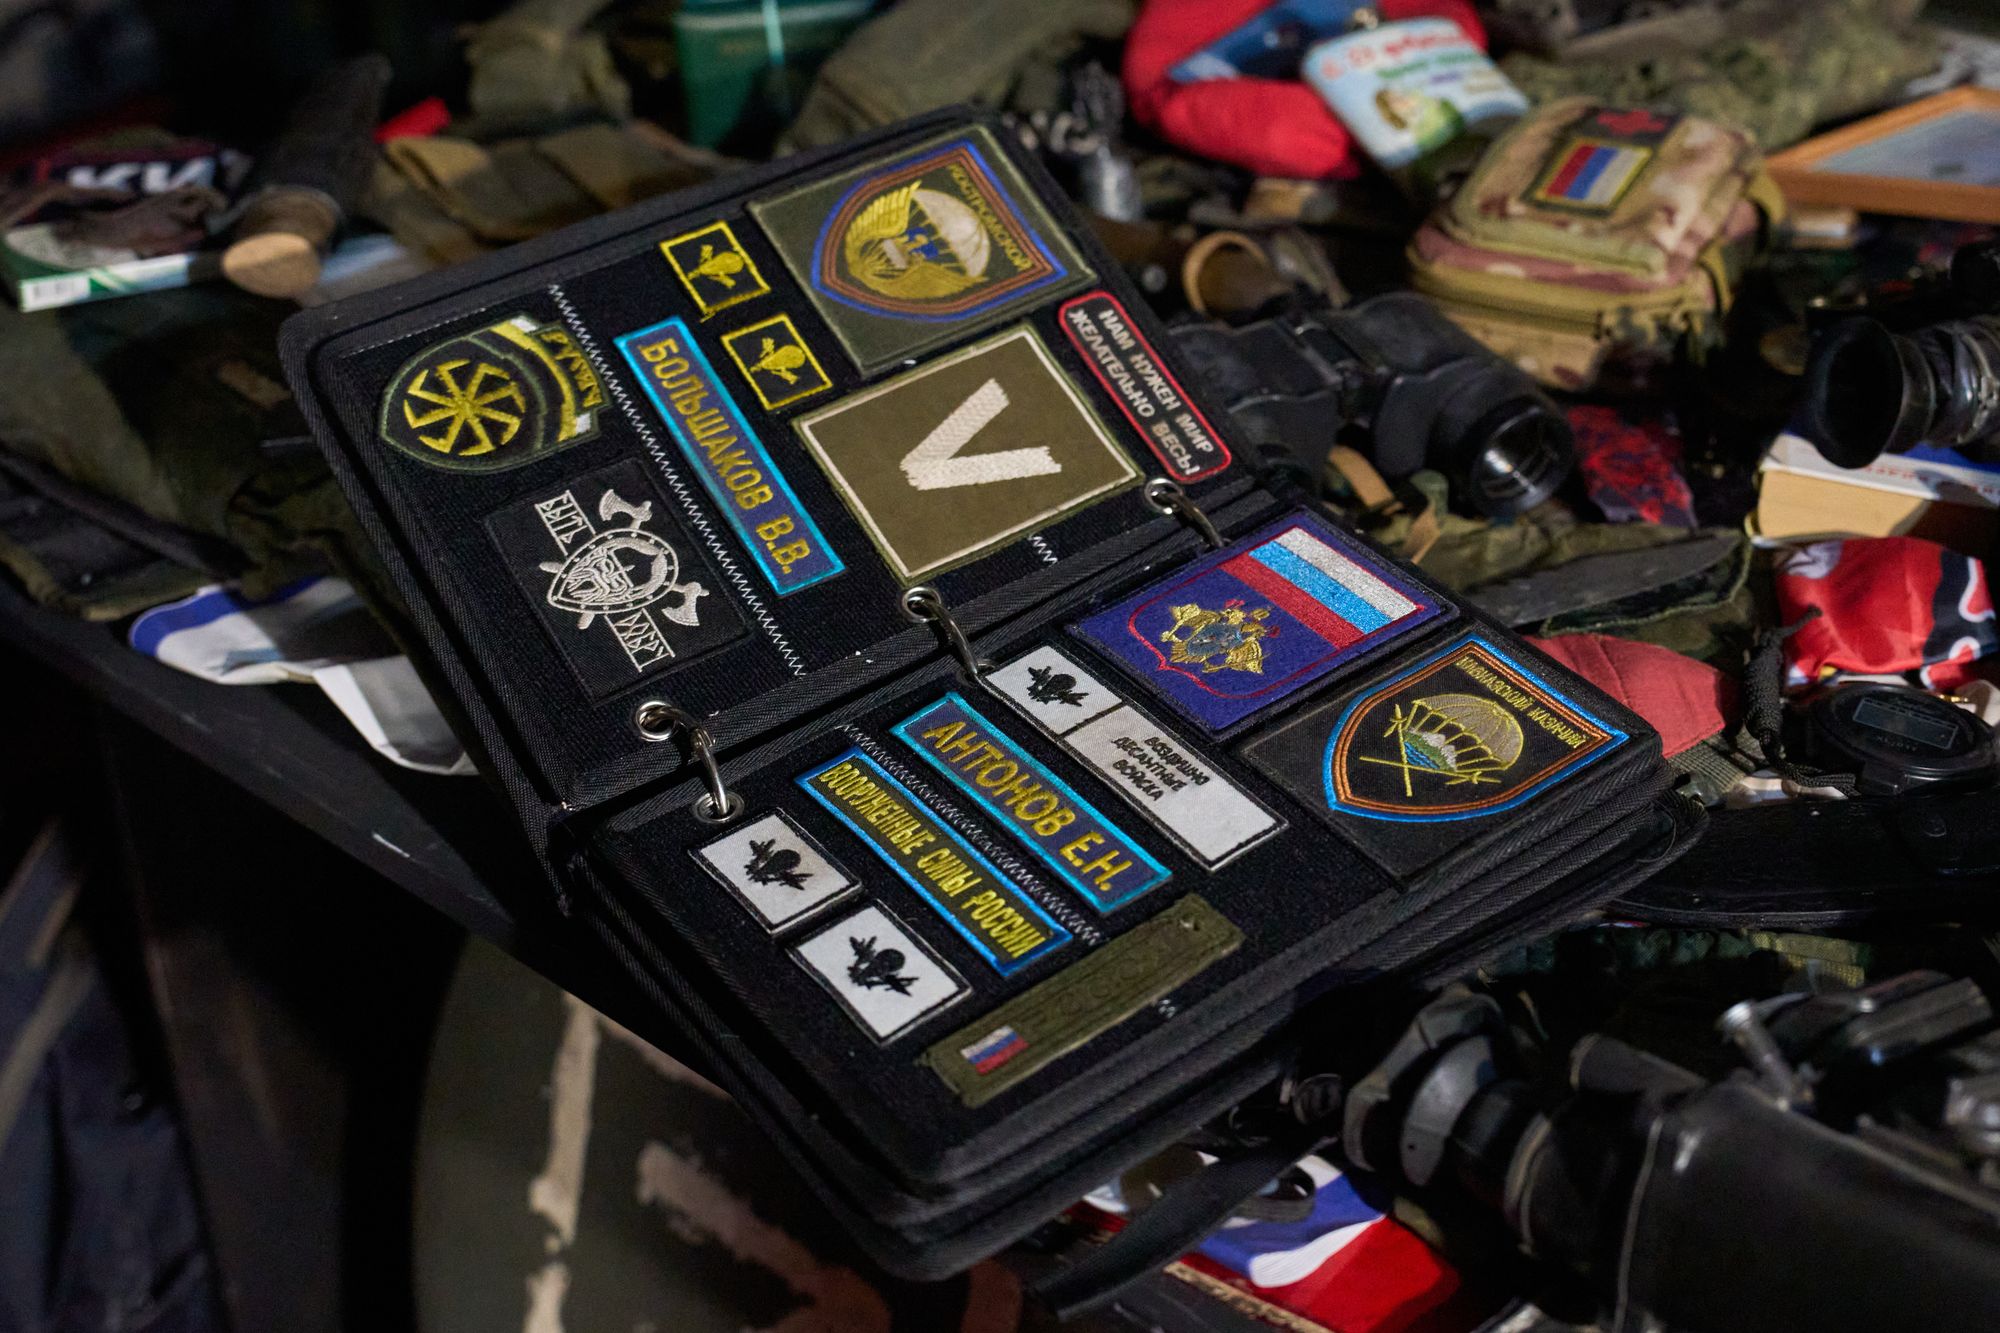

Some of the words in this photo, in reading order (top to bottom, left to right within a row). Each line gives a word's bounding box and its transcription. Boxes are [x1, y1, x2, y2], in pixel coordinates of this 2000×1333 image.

[948, 163, 1034, 272] КОСТРОМСКОЙ
[1067, 309, 1156, 418] ЖЕЛАТЕЛЬНО
[1098, 308, 1136, 351] НАМ
[1129, 352, 1182, 411] НУЖЕН
[1175, 412, 1214, 454] МИР
[637, 337, 774, 510] БОЛЬШАКОВ
[755, 514, 810, 574] В.В.
[900, 378, 1062, 491] V
[922, 720, 1076, 836] АНТОНОВ
[1059, 831, 1133, 892] Е.Н.
[1111, 736, 1188, 792] ДЕСАНТНЫЕ
[1144, 736, 1211, 786] ВОЗДУШНО
[818, 762, 936, 856] ВООРУЖЕННЫЕ
[916, 848, 983, 898] СИЛЫ
[960, 890, 1047, 959] РОССИИ
